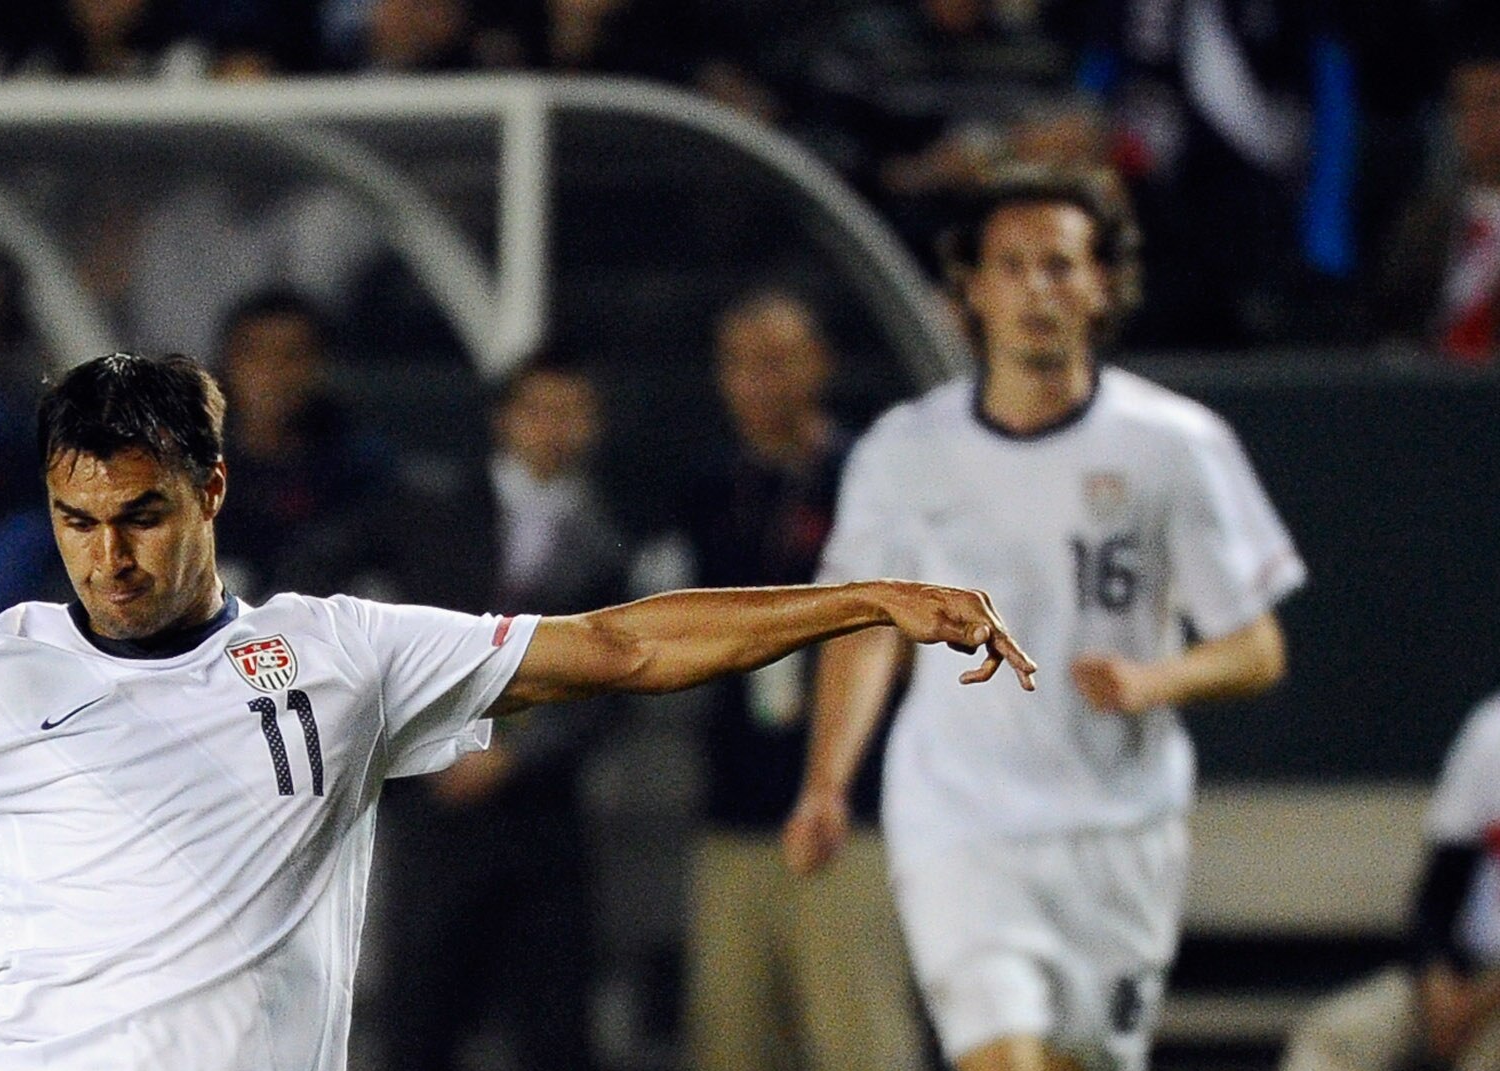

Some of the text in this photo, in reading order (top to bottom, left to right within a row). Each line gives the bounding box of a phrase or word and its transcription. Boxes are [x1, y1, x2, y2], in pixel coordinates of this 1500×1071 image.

[1070, 532, 1140, 616] 16
[242, 649, 289, 676] US
[247, 689, 324, 797] 11
